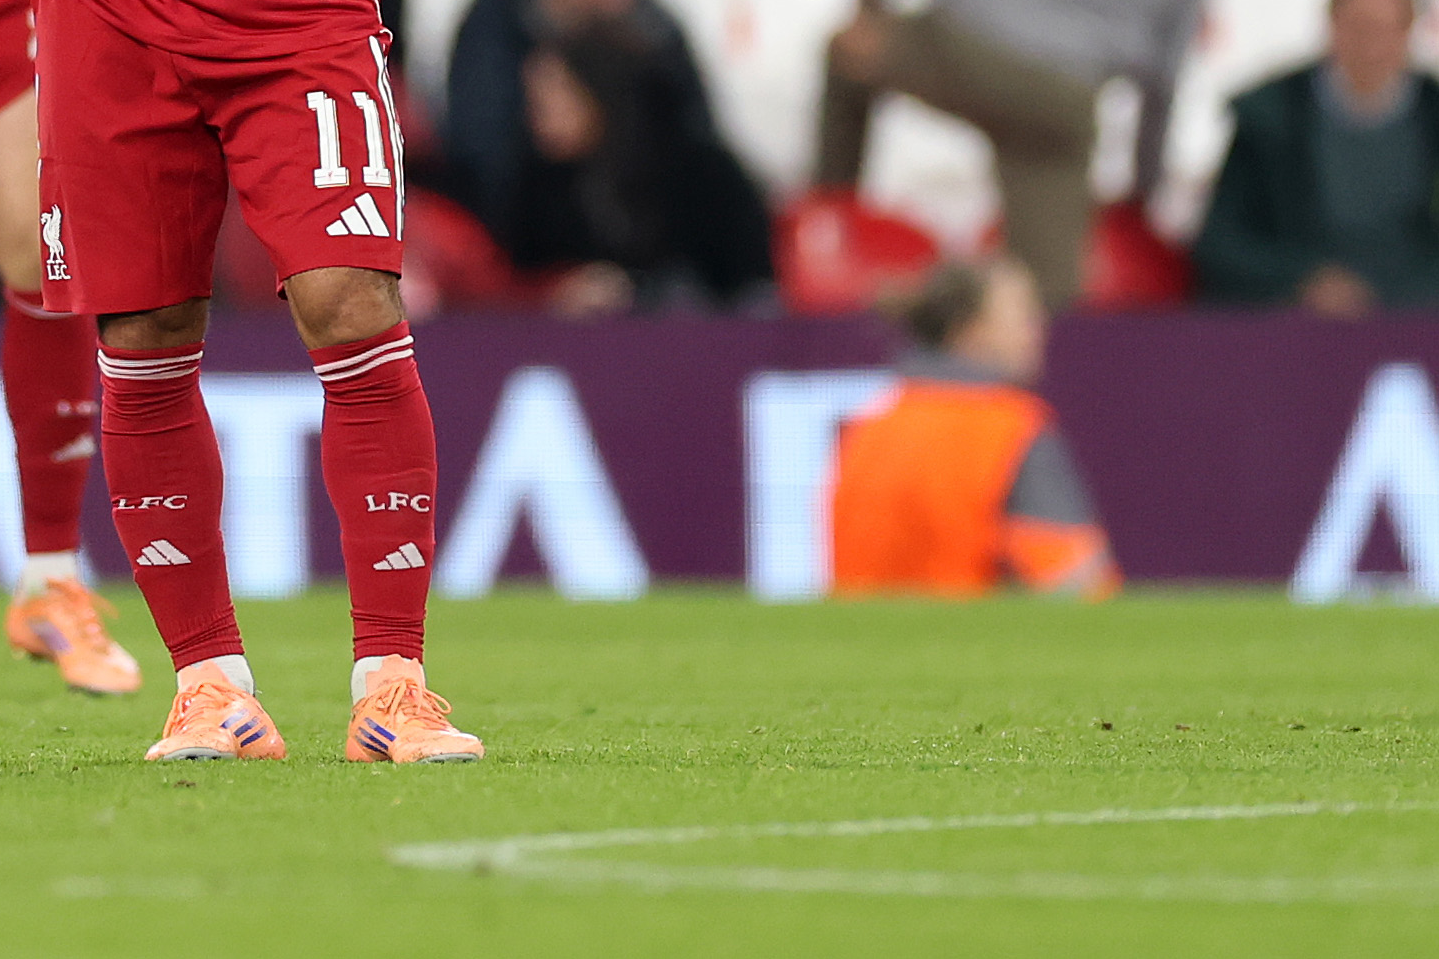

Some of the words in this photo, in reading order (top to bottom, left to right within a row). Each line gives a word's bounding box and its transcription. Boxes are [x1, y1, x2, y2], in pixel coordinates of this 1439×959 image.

[306, 91, 392, 189] 11
[118, 495, 188, 509] LFC
[365, 492, 431, 513] LFC
